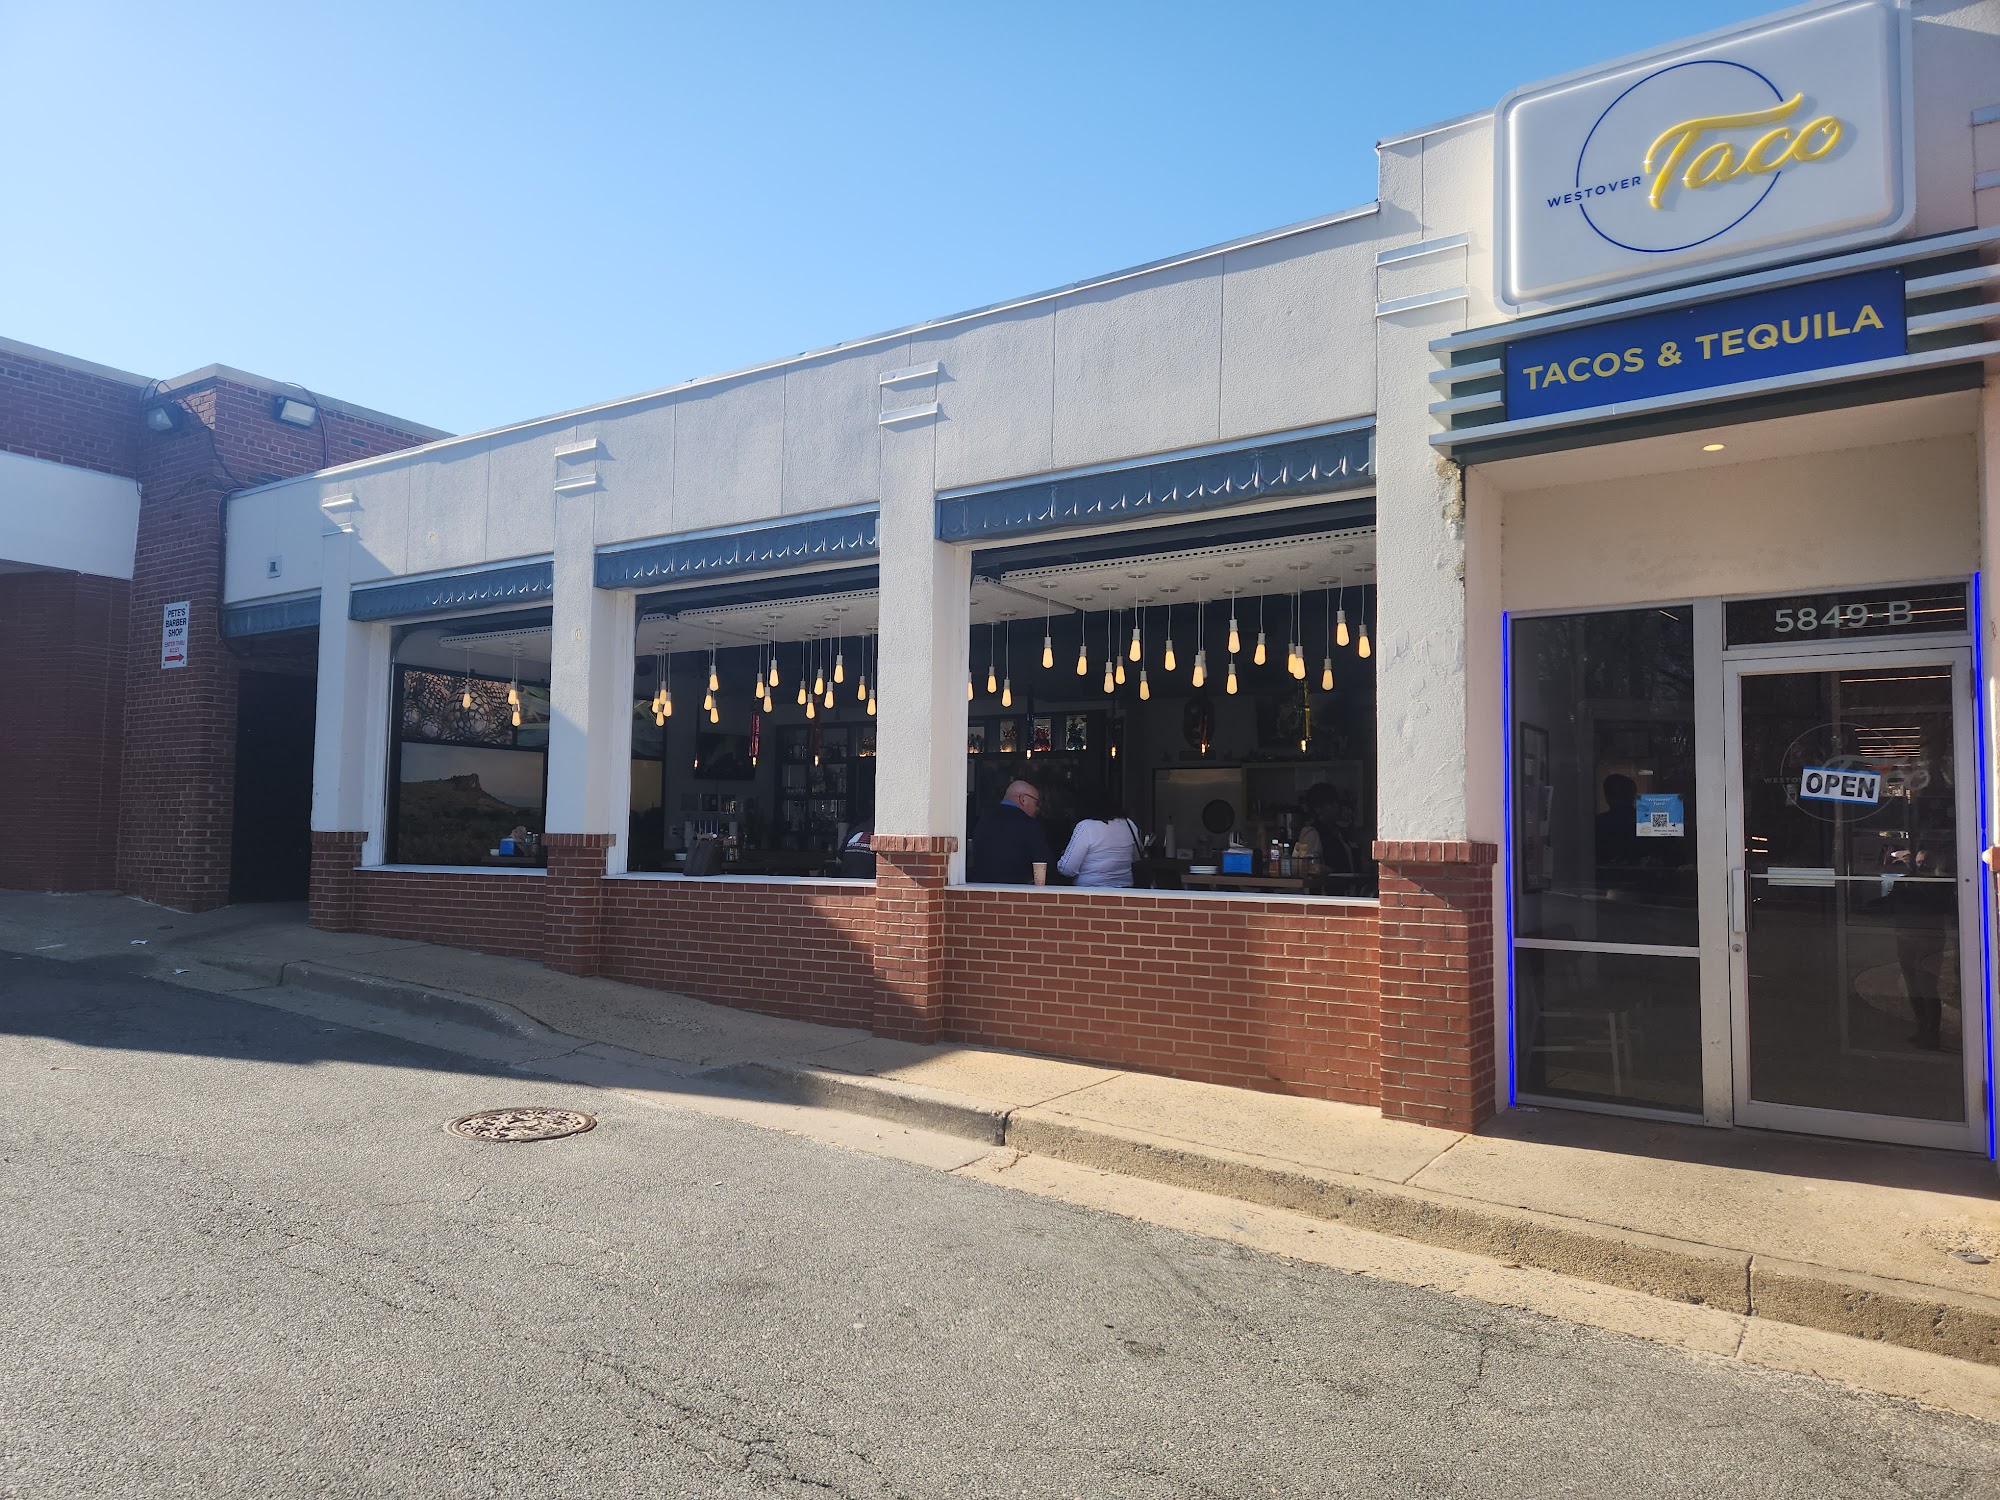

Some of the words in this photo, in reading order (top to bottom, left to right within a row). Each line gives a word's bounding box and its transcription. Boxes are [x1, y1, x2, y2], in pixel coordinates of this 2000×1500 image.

[1547, 176, 1641, 208] WESTOVER
[1645, 92, 1842, 210] Taco
[1523, 348, 1644, 390] TACOS
[1657, 341, 1683, 367] &
[1695, 304, 1884, 360] TEQUILA
[166, 618, 186, 628] BARBER
[168, 608, 186, 618] PETE'S
[1774, 600, 1914, 633] 5849-B
[168, 628, 182, 637] SHOP
[1805, 772, 1876, 799] OPEN
